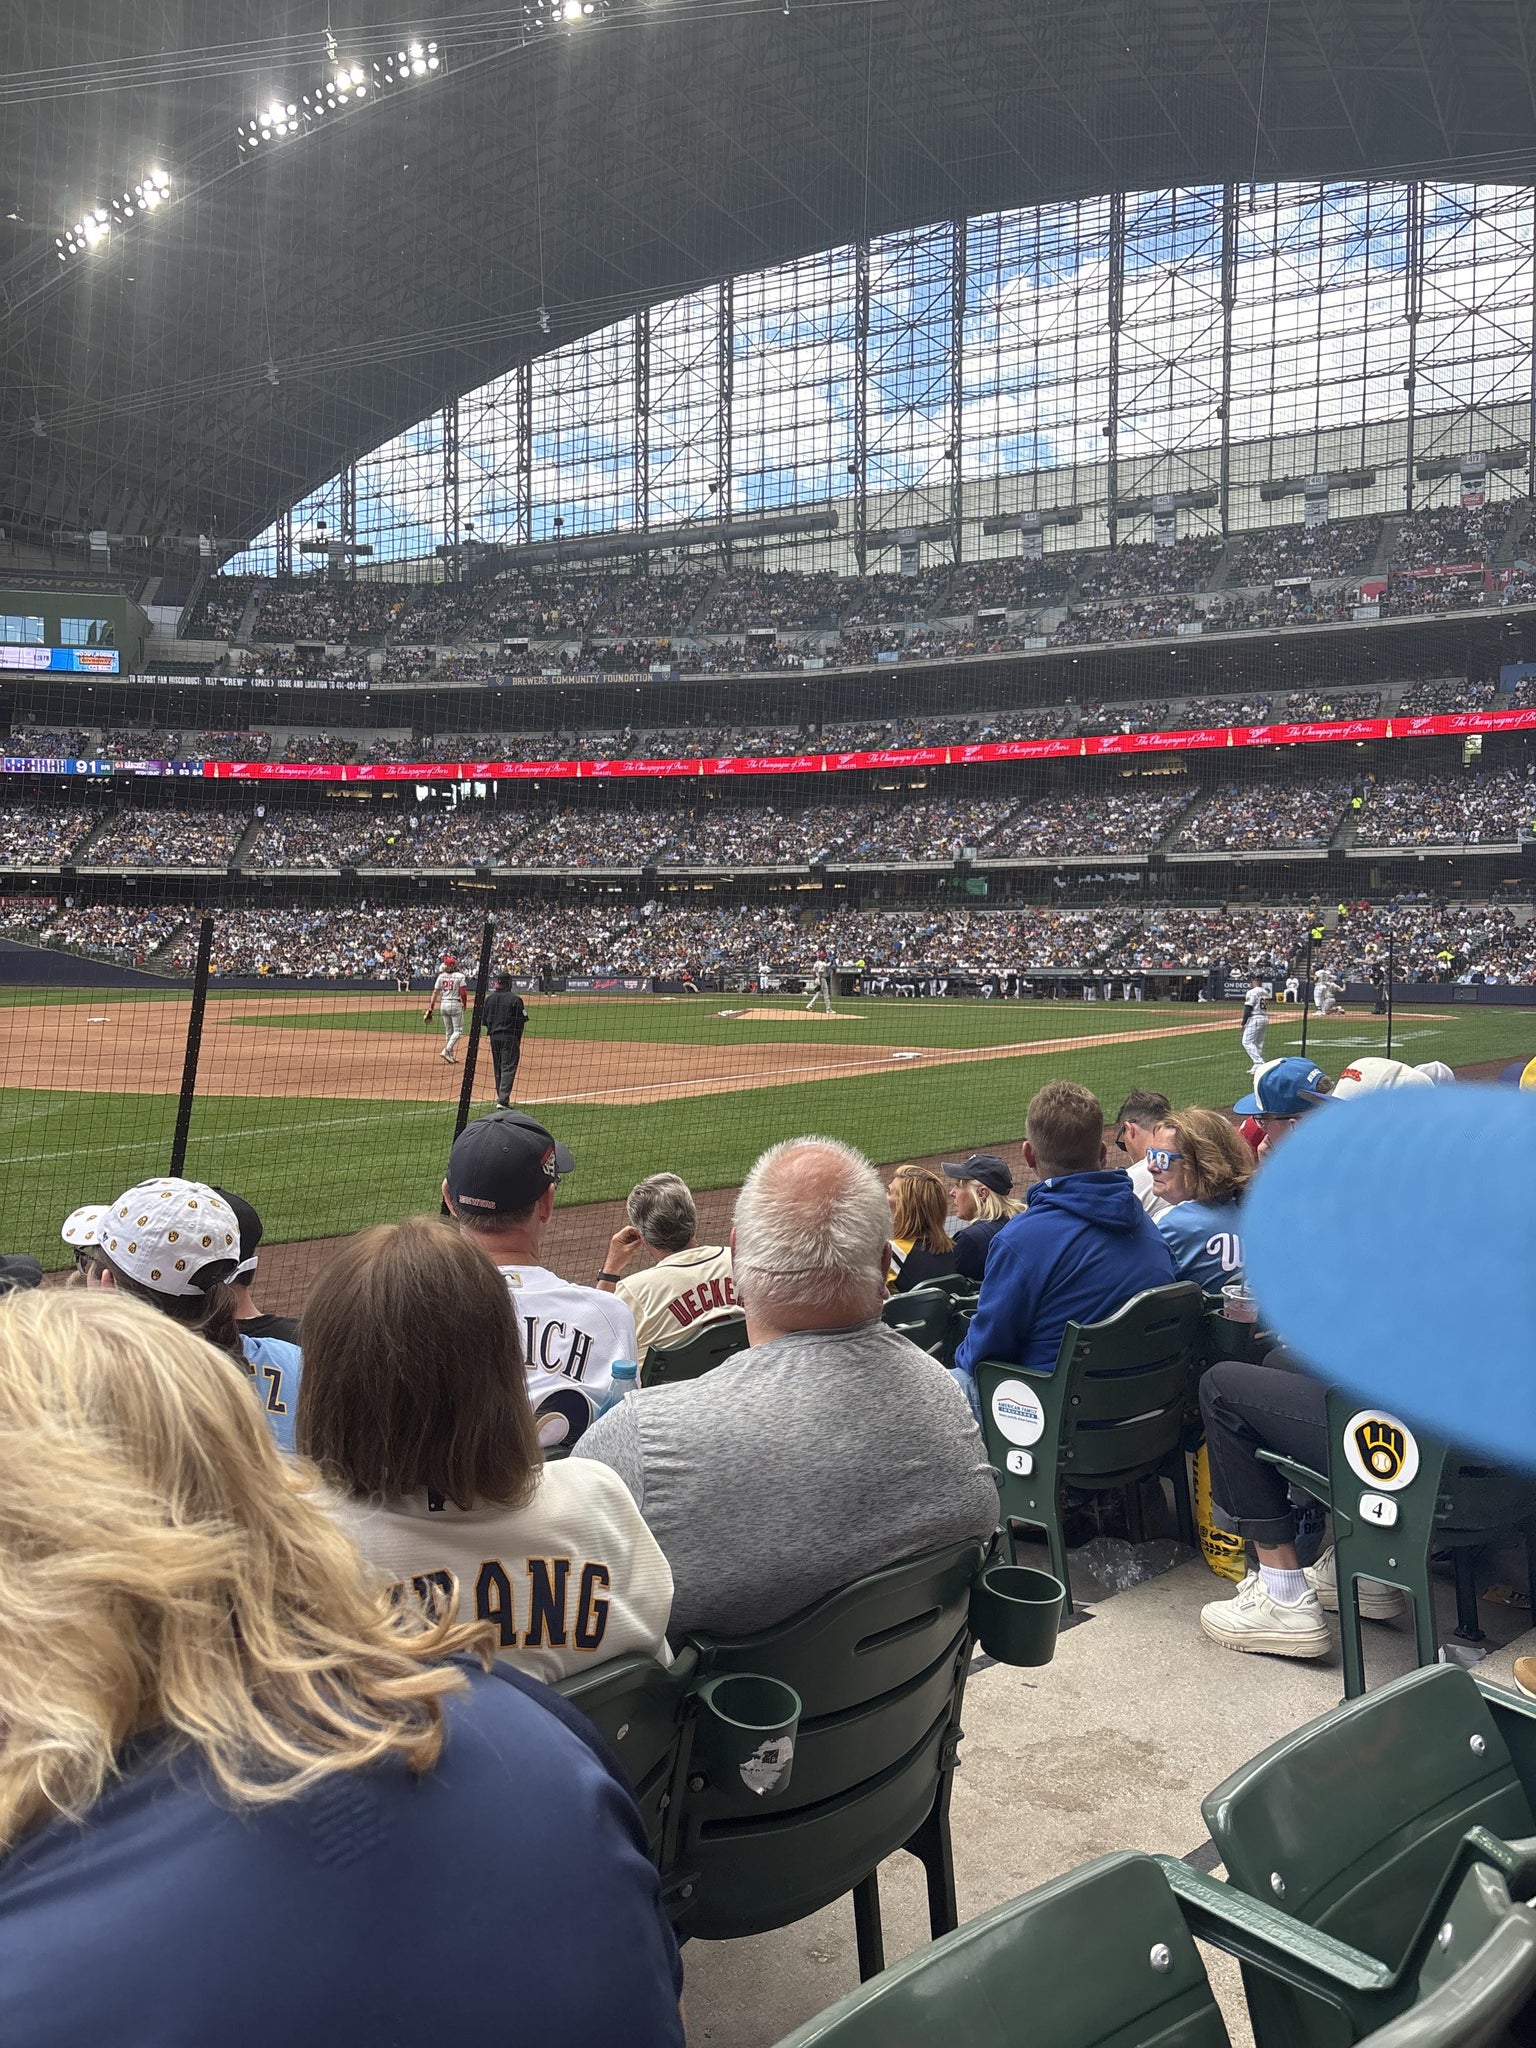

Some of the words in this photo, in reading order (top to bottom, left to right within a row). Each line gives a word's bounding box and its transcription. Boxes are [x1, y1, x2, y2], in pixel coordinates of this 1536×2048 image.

[71, 581, 126, 589] ROW
[129, 675, 136, 683] TO
[137, 675, 156, 684] REPORT
[157, 676, 167, 684] FAN
[168, 676, 202, 685] MISCONDUCT:
[205, 677, 217, 686] TEXT
[277, 680, 292, 688] ISSUE
[293, 680, 303, 688] AND
[304, 680, 328, 689] LOCATION
[329, 681, 336, 690] TO
[512, 676, 548, 686] BREWERS
[551, 674, 600, 684] COMMUNITY
[603, 673, 653, 683] FOUNDATION
[1449, 716, 1467, 727] The
[1468, 716, 1514, 728] Champagne
[1514, 715, 1524, 727] of
[1285, 726, 1300, 737] The
[1301, 726, 1342, 738] Champagne
[1342, 726, 1351, 737] of
[1350, 723, 1373, 734] Beers
[1134, 736, 1148, 746] The
[1149, 735, 1187, 747] Champagne
[1187, 735, 1195, 746] of
[995, 745, 1008, 755] The
[1009, 744, 1041, 756] Champagne
[1042, 744, 1050, 755] of
[866, 753, 879, 763] The
[880, 753, 911, 764] Champagne
[912, 753, 920, 764] of
[76, 760, 96, 773] 91
[261, 765, 274, 774] The
[275, 766, 308, 776] Champagne
[308, 767, 315, 777] of
[744, 760, 757, 769] The
[758, 760, 790, 771] Champagne
[790, 761, 797, 771] of
[998, 1402, 1020, 1411] AMERICAN
[1021, 1406, 1038, 1414] FAMILY
[1015, 1455, 1023, 1470] 3
[1372, 1502, 1383, 1518] 4
